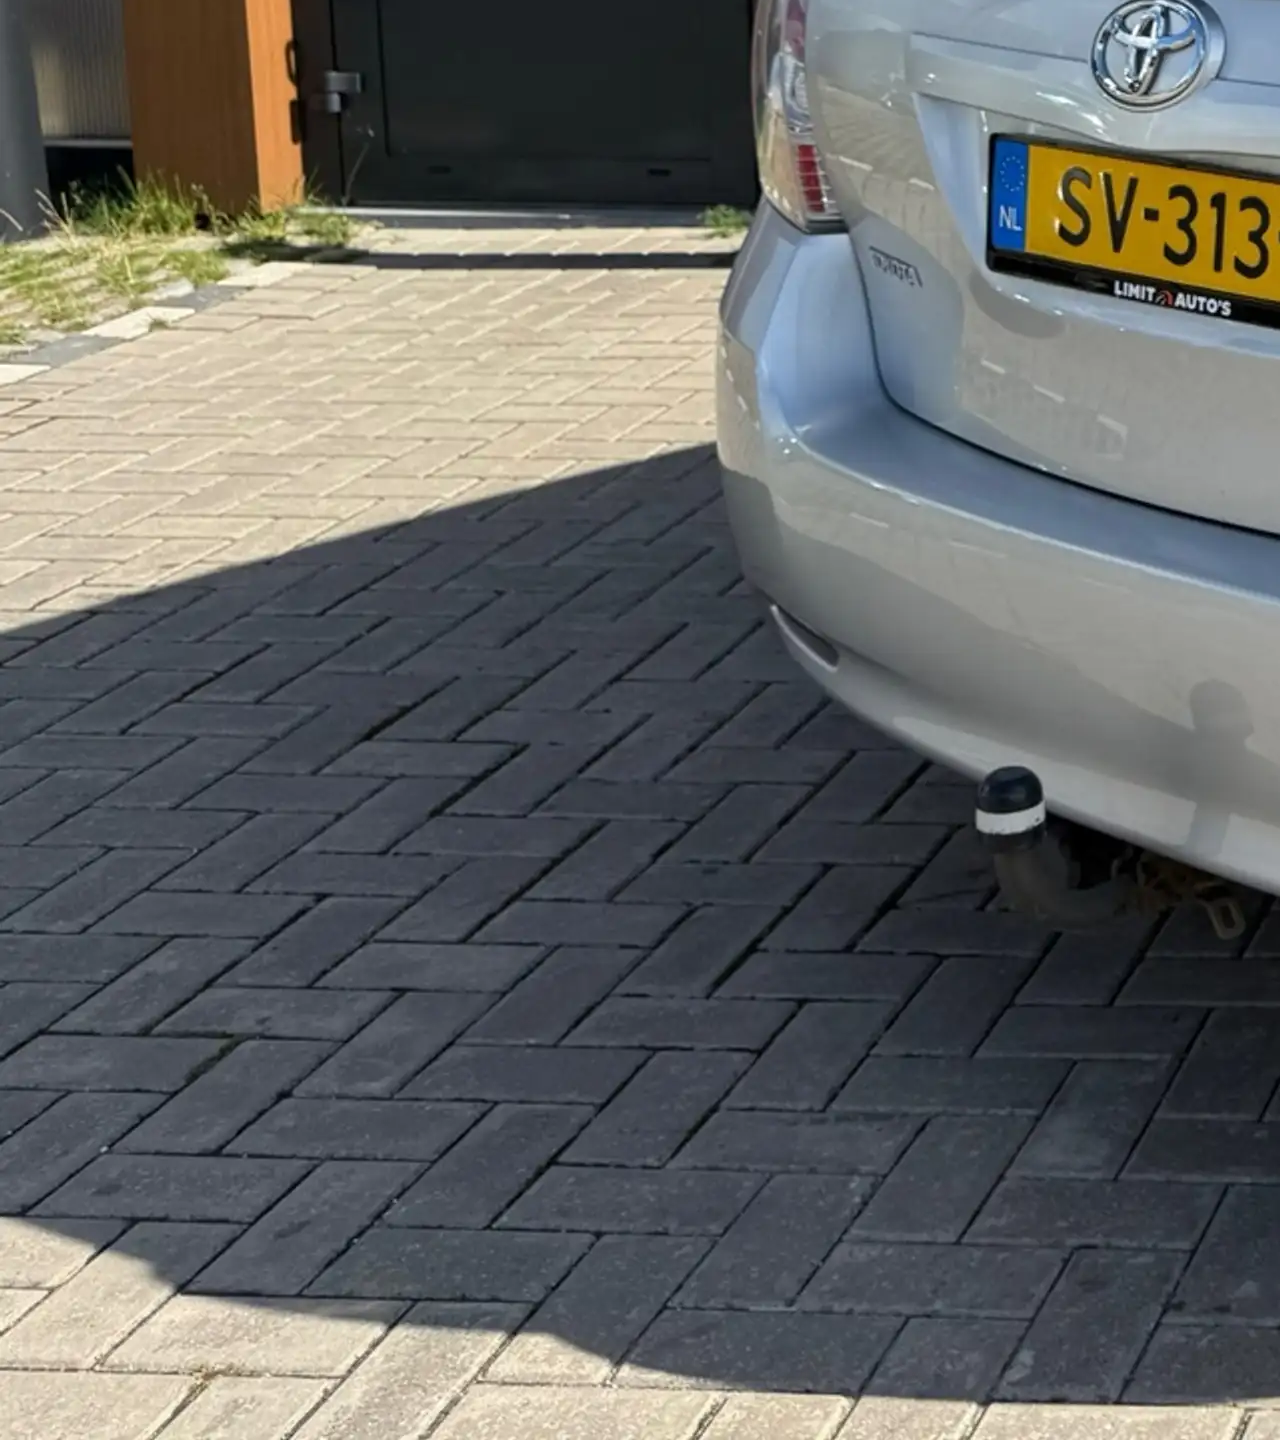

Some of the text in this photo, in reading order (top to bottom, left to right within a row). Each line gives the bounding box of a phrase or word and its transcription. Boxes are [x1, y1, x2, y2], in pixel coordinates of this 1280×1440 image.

[998, 204, 1024, 232] NL
[1113, 279, 1232, 317] LIMIT AUTO'S
